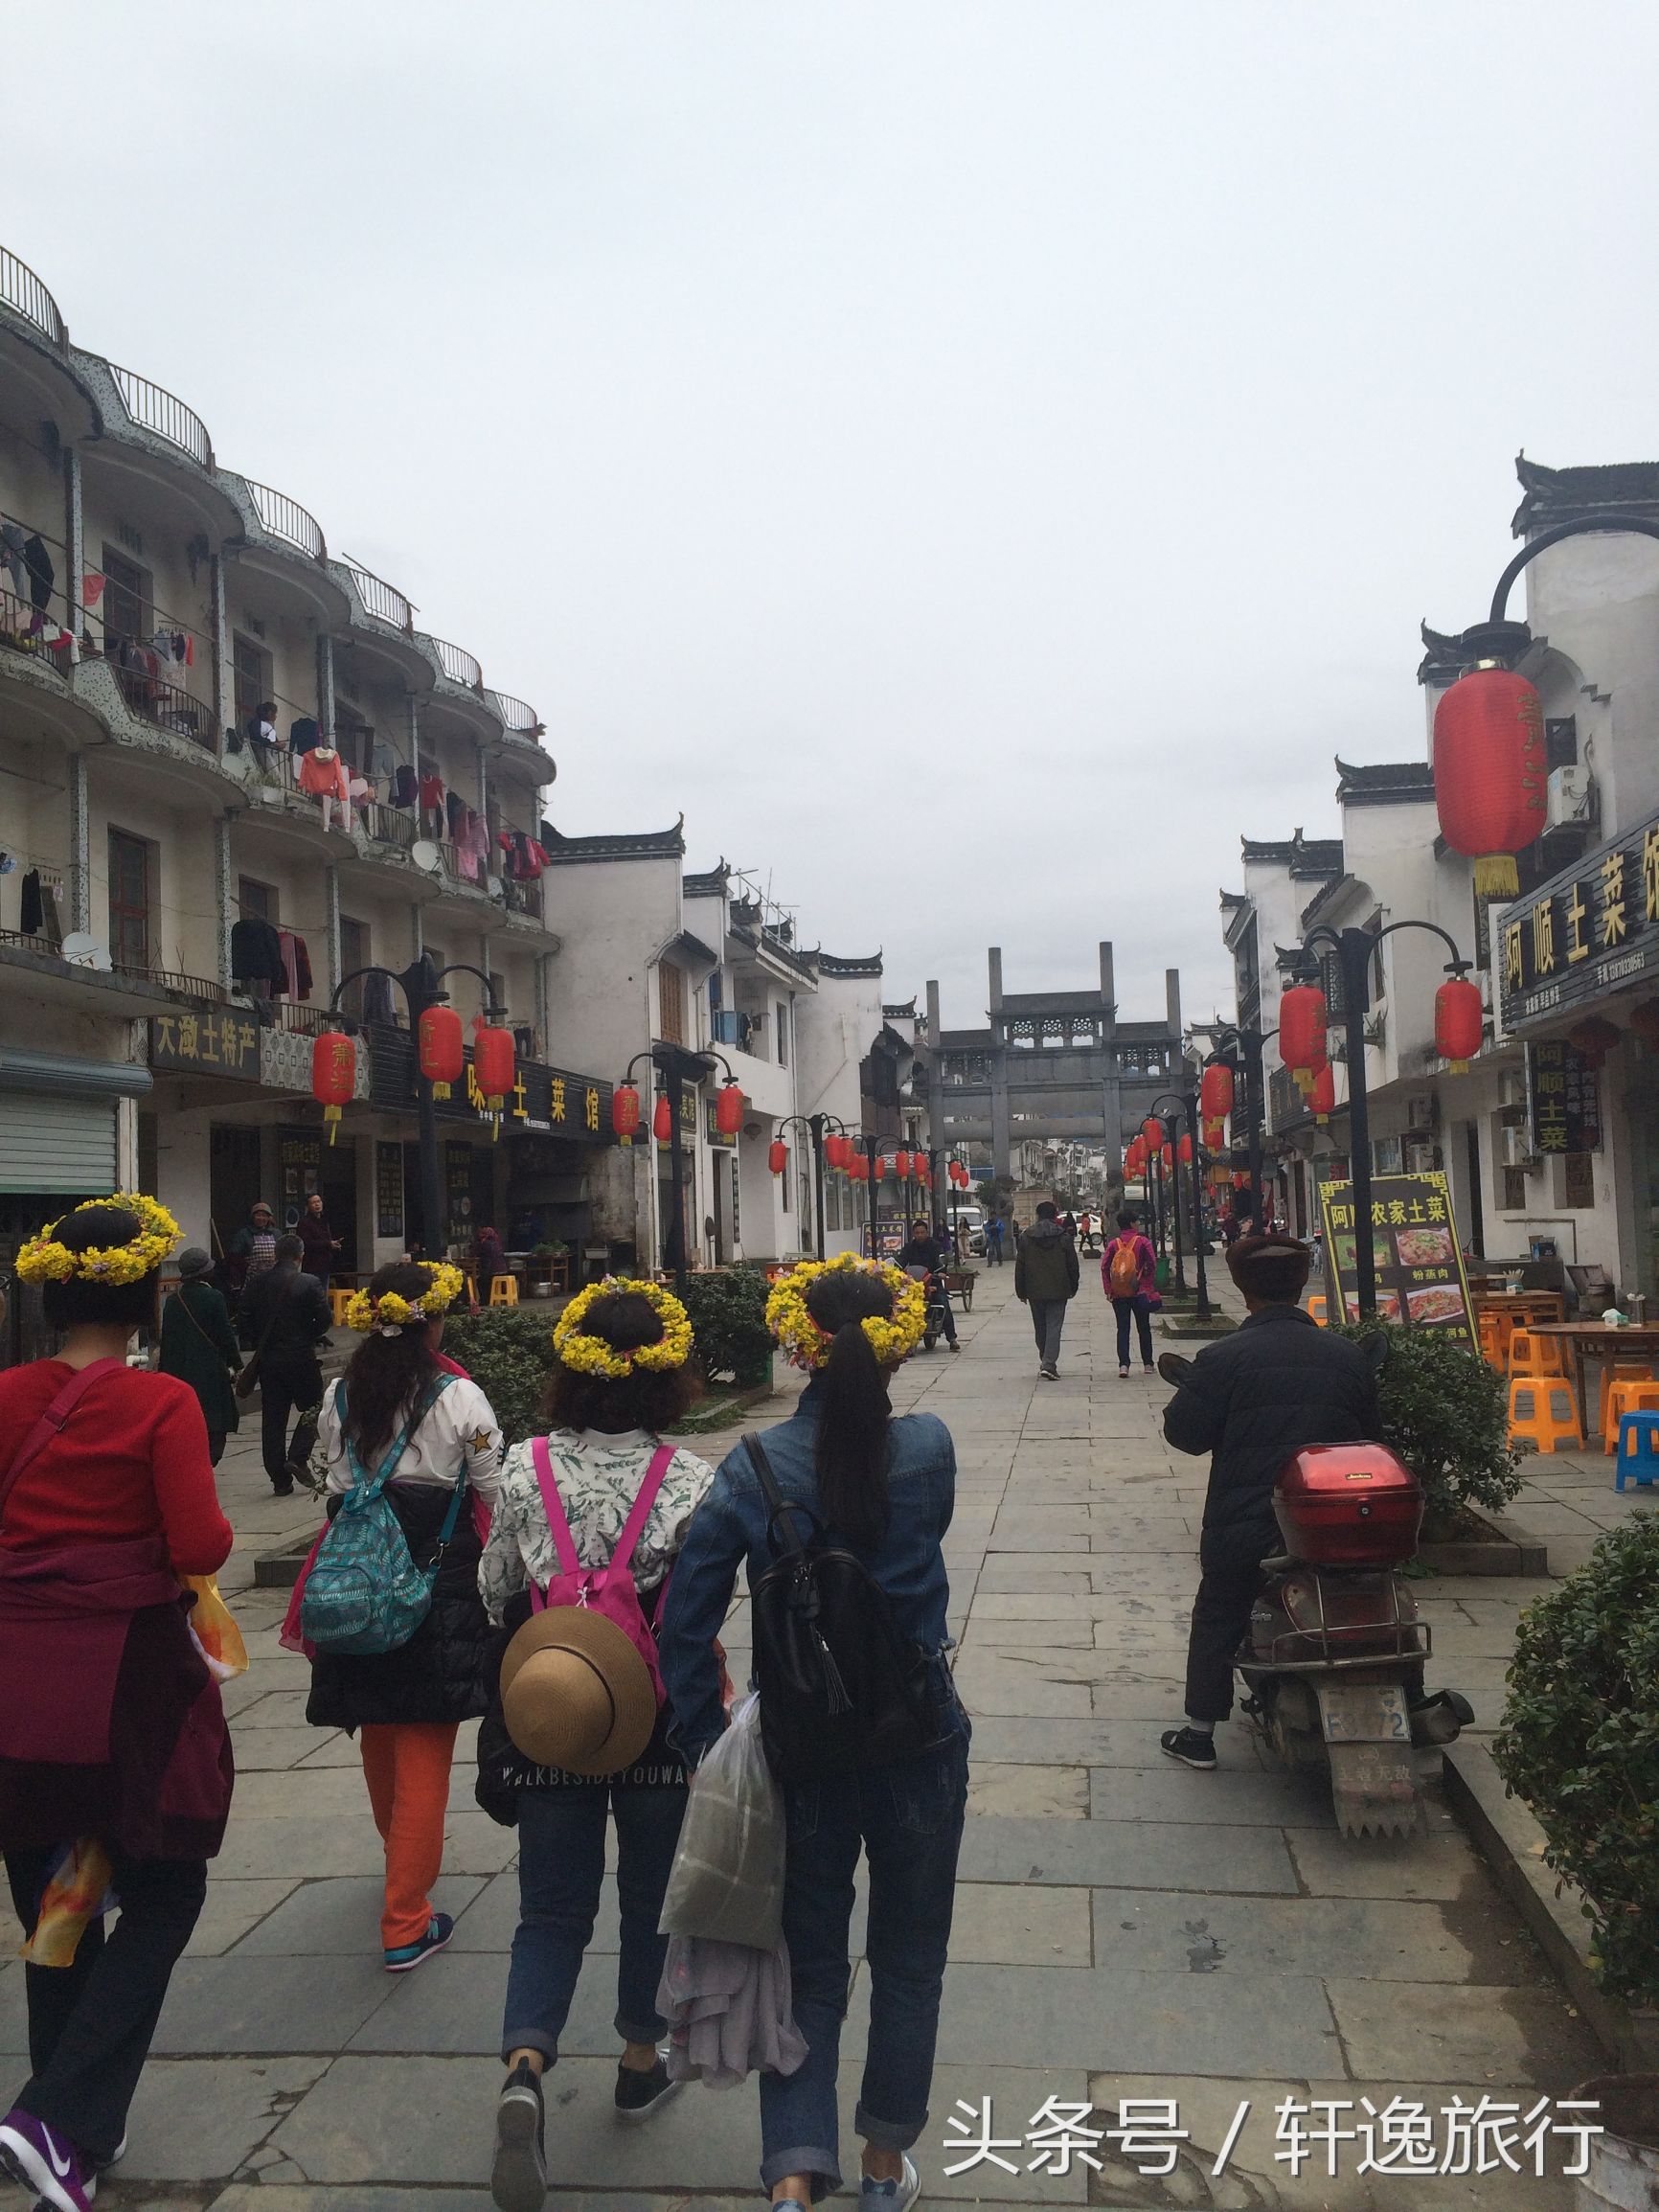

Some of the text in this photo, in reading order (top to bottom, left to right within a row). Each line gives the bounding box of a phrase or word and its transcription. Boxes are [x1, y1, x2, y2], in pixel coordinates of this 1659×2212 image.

[415, 1063, 599, 1131] 味土菜馆
[1536, 1043, 1567, 1151] 阿顺土菜
[1330, 1196, 1446, 1230] 阿农家土菜
